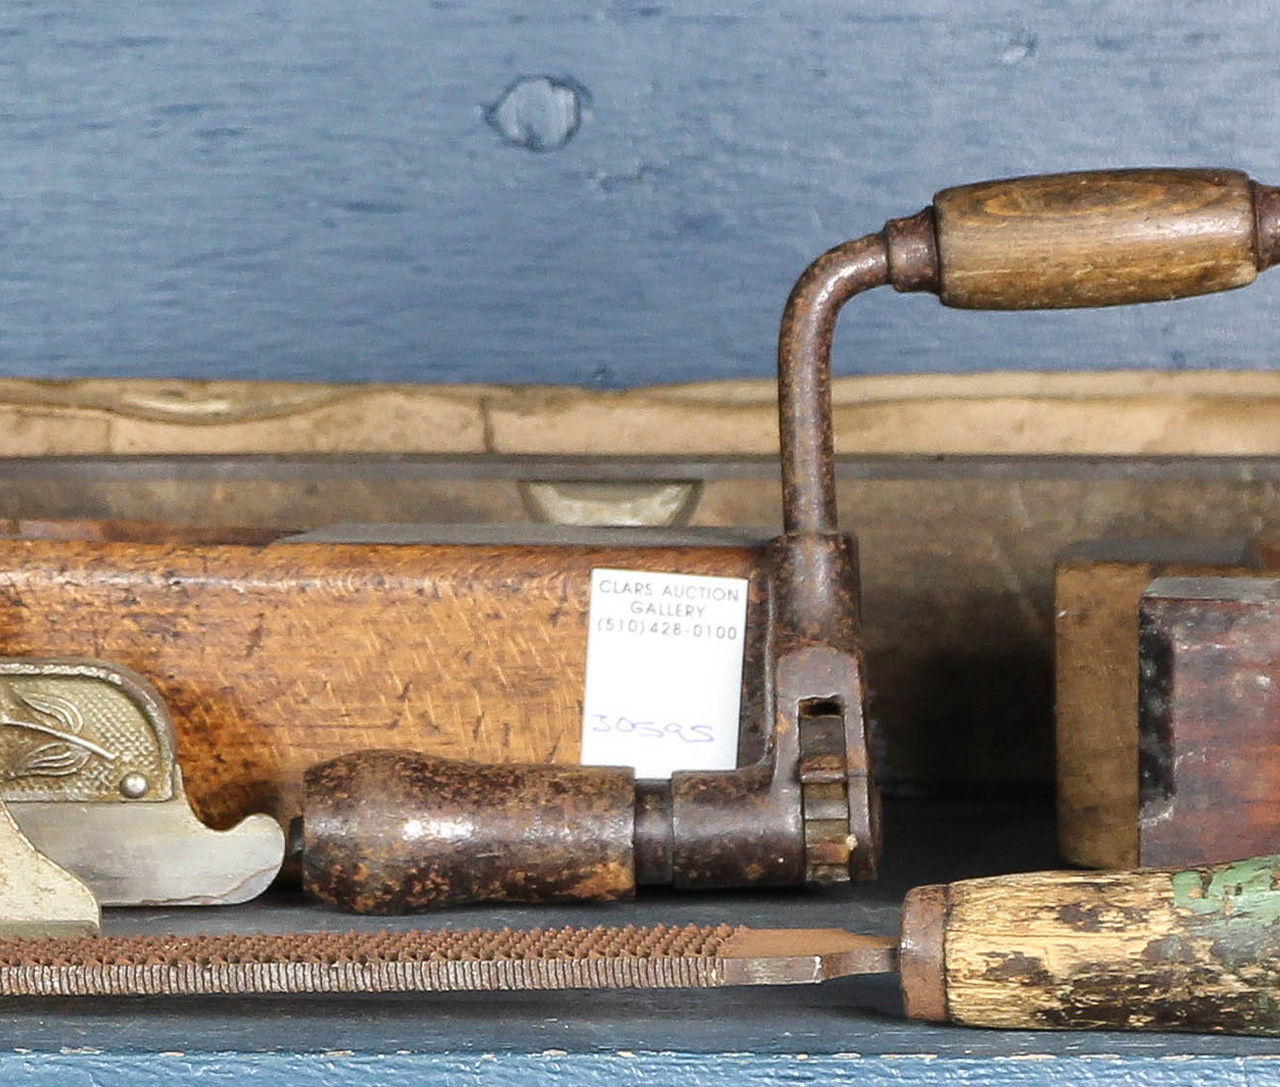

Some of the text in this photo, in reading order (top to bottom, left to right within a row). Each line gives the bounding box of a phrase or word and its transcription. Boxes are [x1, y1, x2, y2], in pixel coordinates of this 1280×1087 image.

[599, 579, 740, 603] CLARS AUCTION
[630, 600, 706, 619] GALLERY
[597, 617, 738, 641] (510)428-0100
